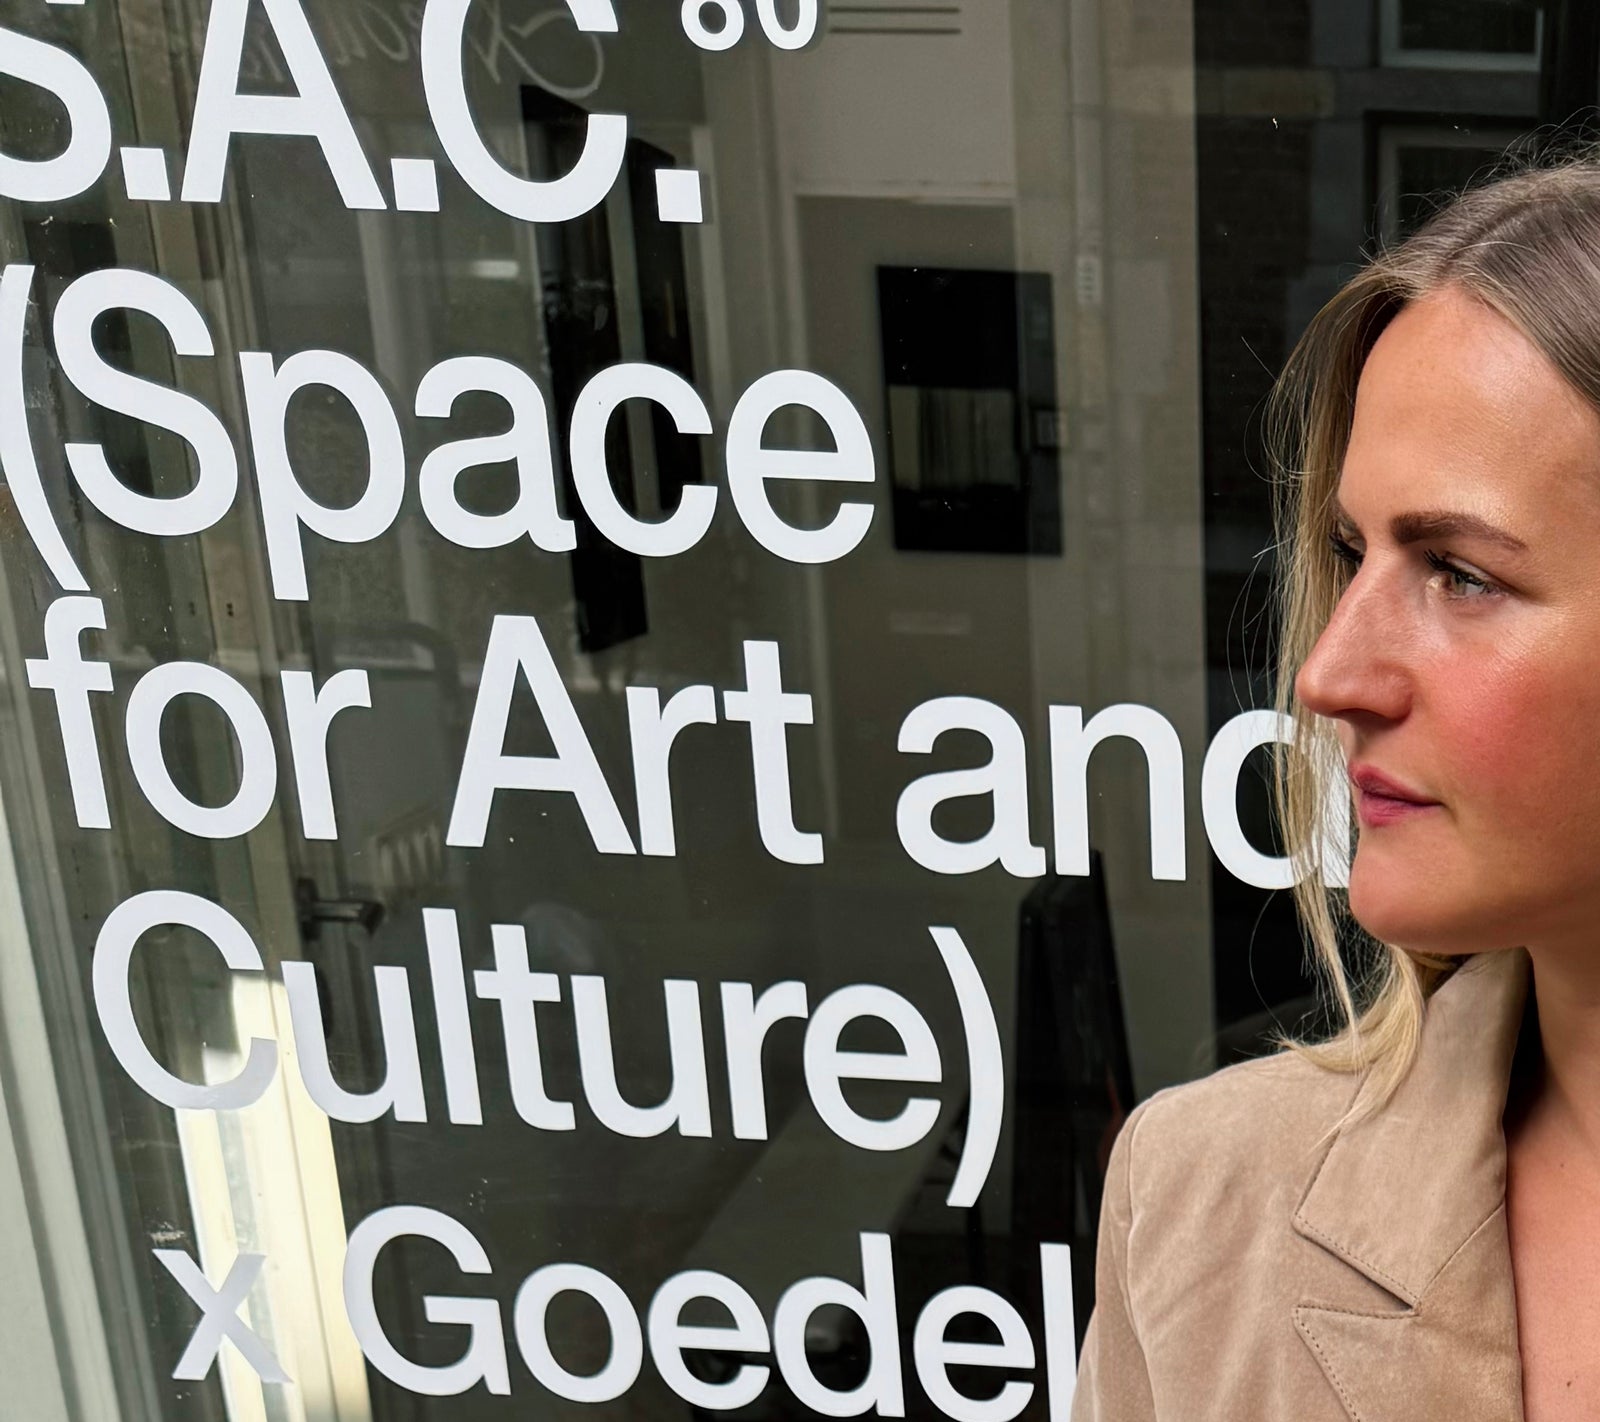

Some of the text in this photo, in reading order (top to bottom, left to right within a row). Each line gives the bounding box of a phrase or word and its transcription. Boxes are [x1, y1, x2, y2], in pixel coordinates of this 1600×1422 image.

[0, 265, 875, 600] (Space
[25, 596, 371, 840] for
[446, 615, 824, 864] Art
[92, 889, 1004, 1207] Culture)
[152, 1249, 293, 1384] x
